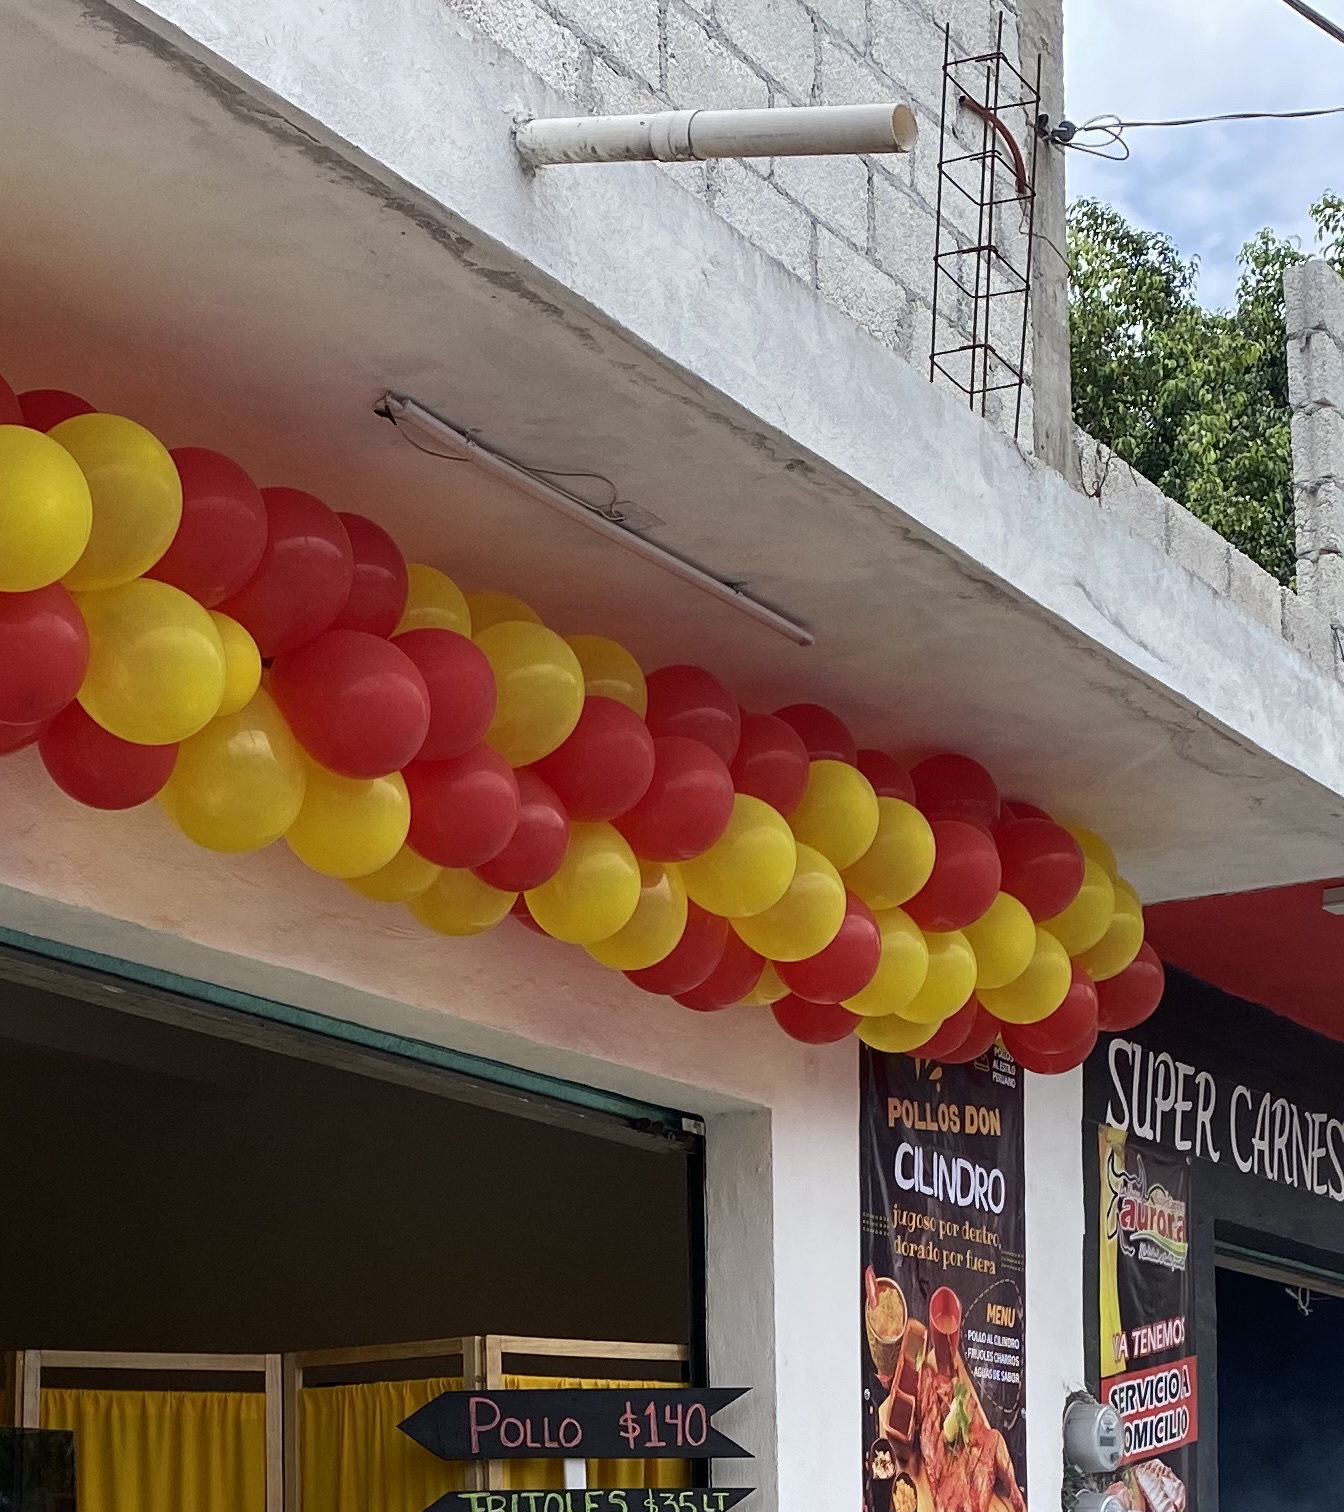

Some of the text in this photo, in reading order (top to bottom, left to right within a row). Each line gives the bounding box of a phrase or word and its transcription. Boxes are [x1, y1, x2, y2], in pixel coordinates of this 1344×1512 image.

[887, 1096, 1002, 1136] POLLOS DON
[1106, 1038, 1220, 1163] SUPER
[894, 1142, 1006, 1215] CILINDRO
[892, 1204, 936, 1236] jugoso
[939, 1218, 960, 1240] por
[1119, 1197, 1186, 1244] aurora
[893, 1235, 997, 1275] dorado por fuera
[987, 1302, 1016, 1328] MENU
[1131, 1317, 1186, 1358] TENEMOS
[1110, 1370, 1180, 1416] SERVICIO
[619, 1401, 708, 1450] $140
[1123, 1405, 1189, 1457] OMICILIO
